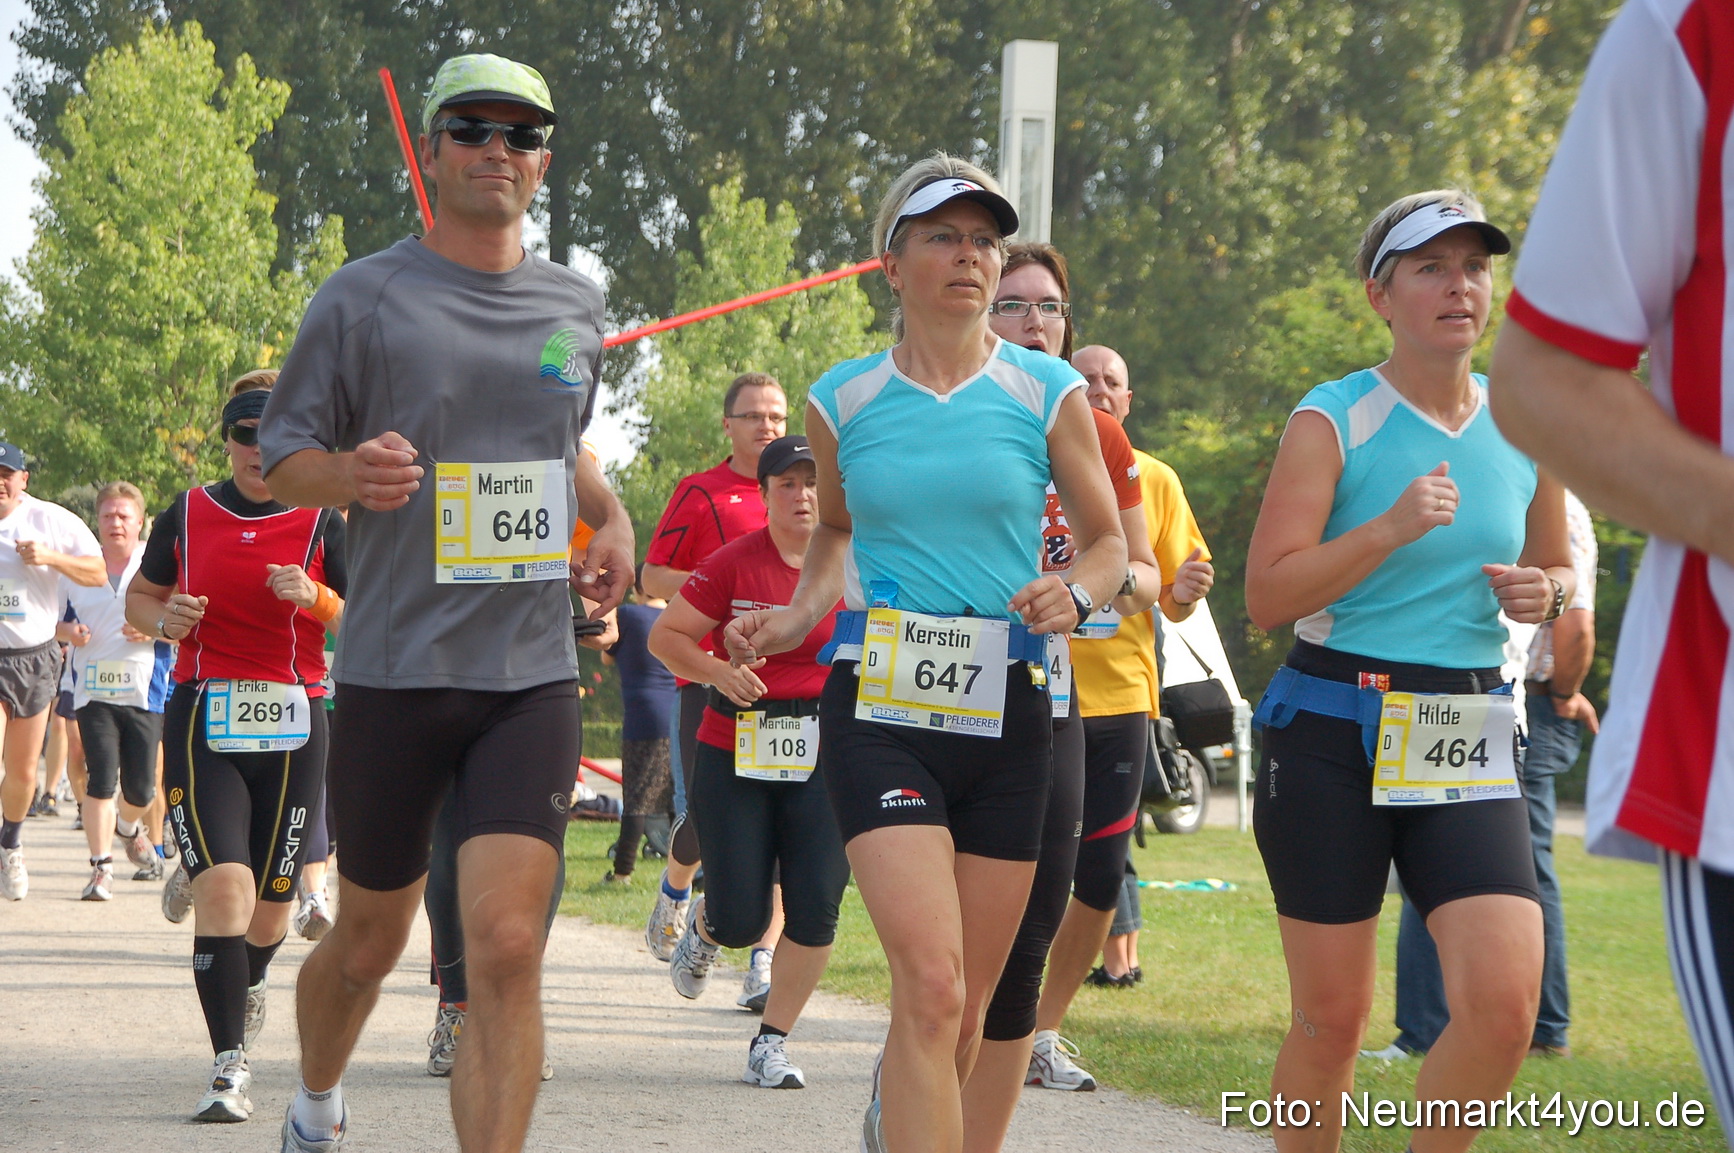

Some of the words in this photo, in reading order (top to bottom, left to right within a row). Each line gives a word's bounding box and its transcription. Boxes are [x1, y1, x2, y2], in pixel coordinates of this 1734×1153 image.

[478, 473, 533, 495] Martin
[443, 509, 452, 525] D
[493, 508, 550, 542] 648
[453, 568, 492, 577] BOCK
[527, 560, 567, 573] PFLEIDERER
[905, 620, 971, 648] Kerstin
[868, 651, 878, 667] D
[99, 672, 131, 683] 6013
[915, 659, 983, 695] 647
[237, 679, 268, 693] Erika
[214, 701, 220, 712] D
[237, 701, 295, 722] 2691
[871, 706, 910, 718] BOCK
[1418, 703, 1460, 725] Hilde
[759, 716, 801, 730] Martina
[946, 714, 999, 729] PFLEIDERER
[768, 738, 806, 757] 108
[1383, 734, 1392, 750] D
[1424, 738, 1489, 768] 464
[1462, 784, 1516, 795] PFLEIDERER
[881, 798, 927, 808] skinfit
[173, 804, 199, 867] SKINS
[279, 806, 307, 876] SKINS
